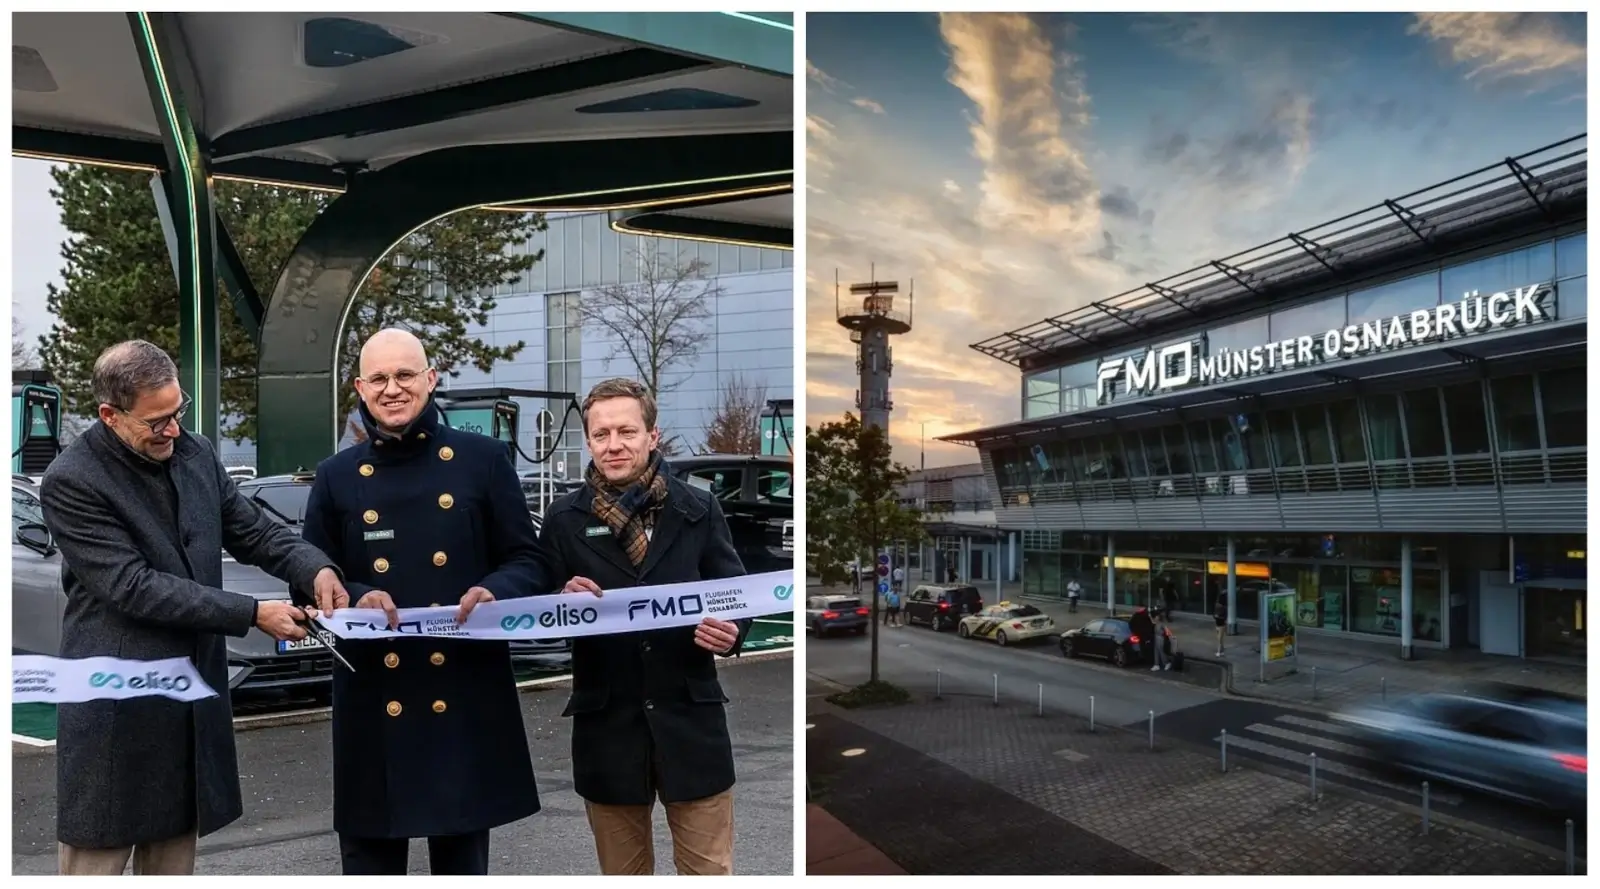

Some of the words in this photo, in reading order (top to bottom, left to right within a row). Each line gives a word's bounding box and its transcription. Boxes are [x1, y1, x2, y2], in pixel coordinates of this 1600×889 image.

[1097, 341, 1191, 400] FMO
[1199, 335, 1314, 381] MÜNSTER
[1323, 284, 1541, 356] OSNABRÜCK
[628, 594, 703, 621] FMO
[706, 596, 737, 606] MÜNSTER
[708, 602, 748, 613] OSNABRÜCK
[539, 603, 597, 628] eliso
[128, 671, 192, 692] eliso
